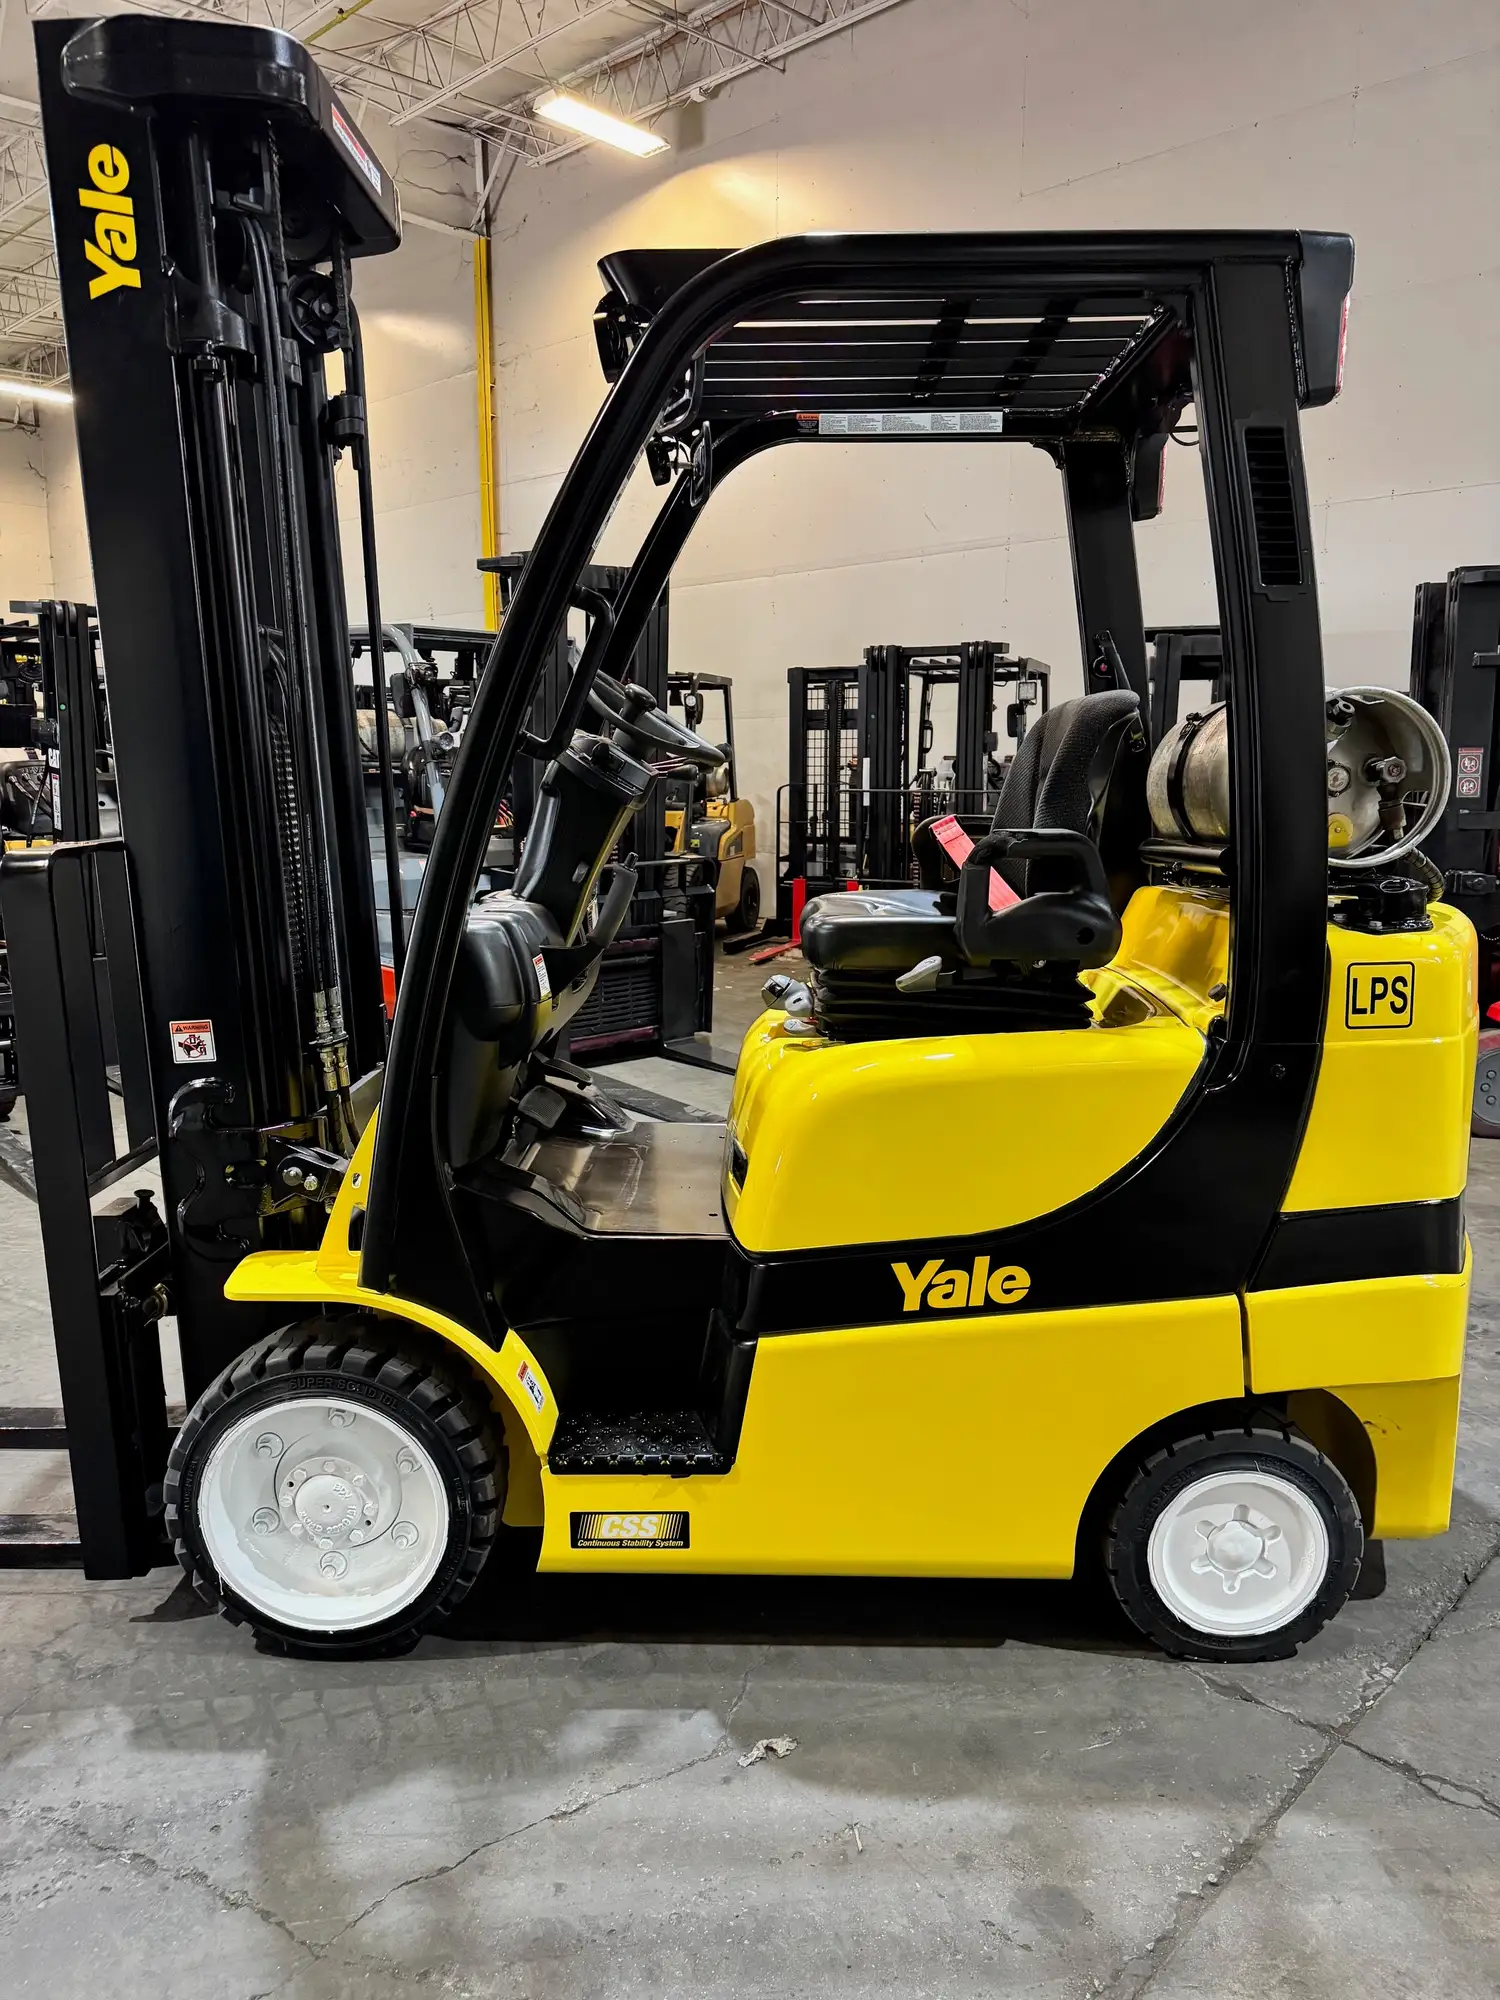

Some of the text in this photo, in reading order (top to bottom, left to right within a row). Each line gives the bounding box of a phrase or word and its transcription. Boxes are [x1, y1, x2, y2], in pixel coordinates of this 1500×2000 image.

[79, 144, 141, 299] Yale
[1351, 977, 1409, 1015] LPS
[892, 1256, 1031, 1312] Yale
[289, 1377, 333, 1390] SUPER
[337, 1379, 377, 1399] SOLID
[601, 1514, 659, 1538] CSS
[577, 1539, 684, 1548] Continuous Stability System
